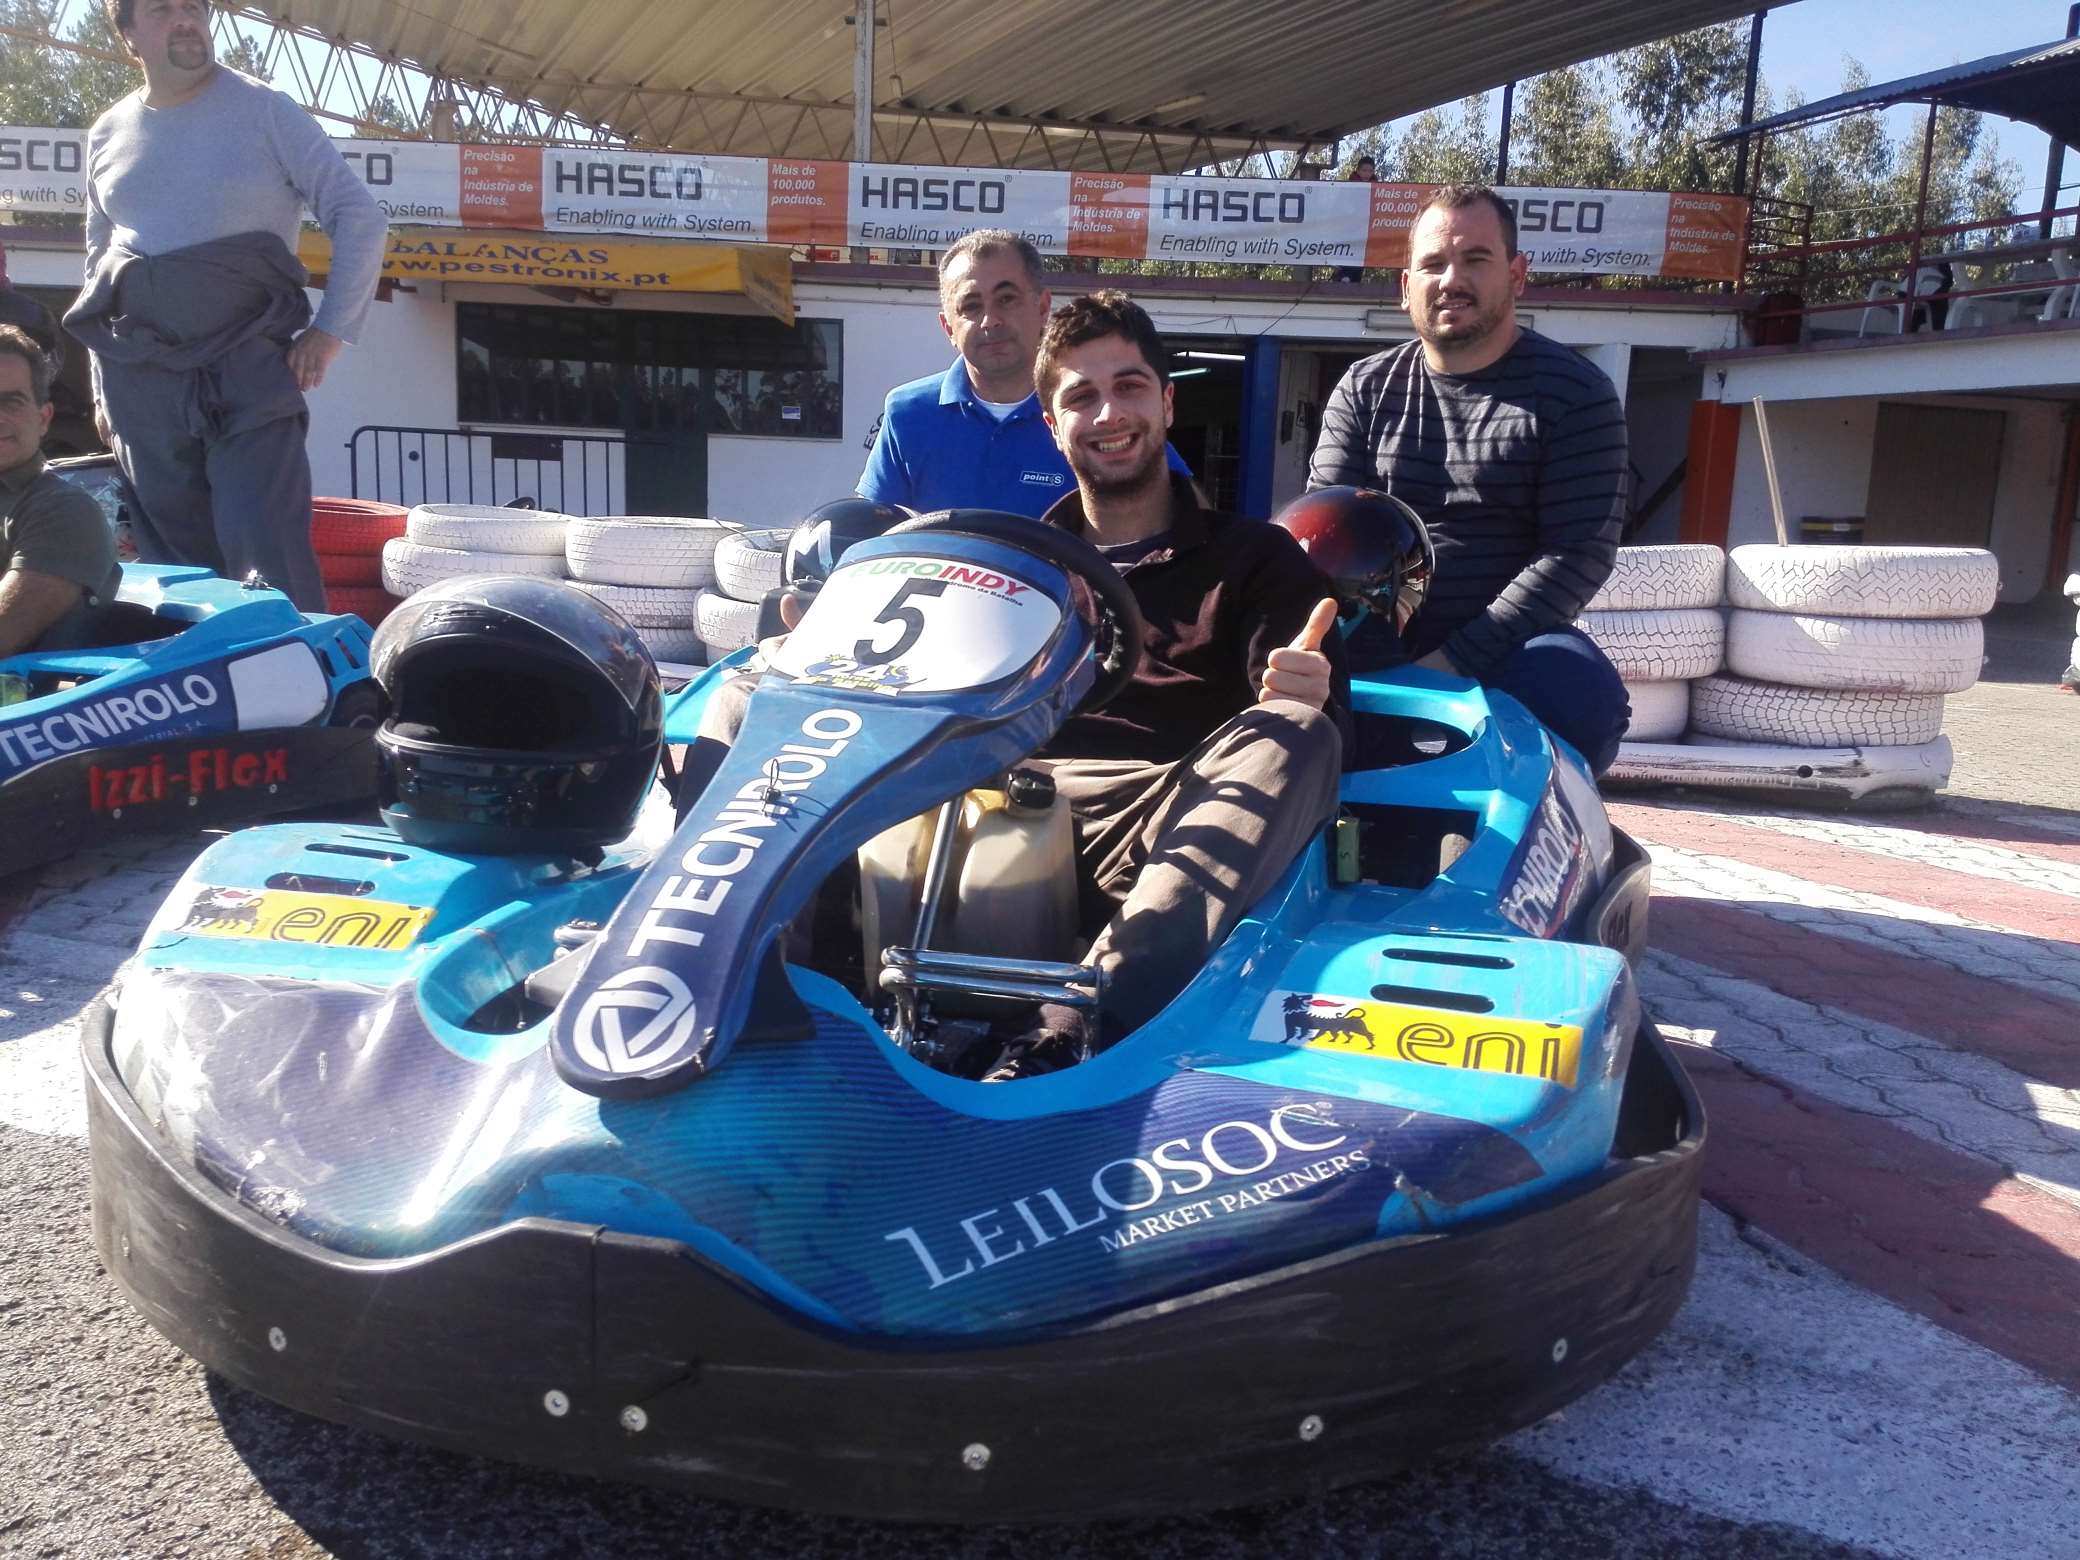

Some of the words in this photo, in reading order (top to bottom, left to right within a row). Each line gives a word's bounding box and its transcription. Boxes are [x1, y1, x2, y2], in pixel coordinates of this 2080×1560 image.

[0, 138, 82, 173] SCO
[463, 165, 479, 176] na
[555, 159, 702, 202] HASCO
[771, 163, 798, 177] Mais
[801, 165, 816, 177] de
[20, 186, 57, 202] with
[518, 181, 534, 193] de
[770, 193, 827, 207] produtos.
[861, 175, 1006, 214] HASCO
[1074, 193, 1088, 203] na
[1374, 187, 1401, 200] Mais
[1403, 188, 1419, 200] de
[1126, 207, 1141, 220] de
[1162, 187, 1305, 224] HASCO
[1503, 198, 1605, 233] SCO
[1671, 213, 1686, 224] na
[555, 206, 636, 232] Enabling
[642, 210, 679, 231] with
[682, 213, 757, 235] System.
[860, 222, 940, 245] Enabling
[1073, 221, 1117, 234] Moldes.
[1160, 234, 1237, 258] Enabling
[1244, 236, 1279, 255] with
[1284, 239, 1355, 260] System.
[1720, 229, 1736, 242] de
[1541, 247, 1577, 264] with
[1582, 248, 1651, 267] System.
[382, 260, 671, 287] w.pestronix.pt
[850, 561, 1032, 597] EUROINDY
[853, 577, 950, 666] 5
[0, 673, 218, 768] TECNIROLO
[87, 748, 289, 811] Izzi-Flex
[625, 708, 864, 958] TECNIROLO
[269, 905, 421, 950] eni
[1395, 1021, 1565, 1081] eni
[884, 1102, 1348, 1290] LEILOSOC
[1098, 1201, 1215, 1255] MARKET
[1223, 1149, 1372, 1215] PARTNERS
